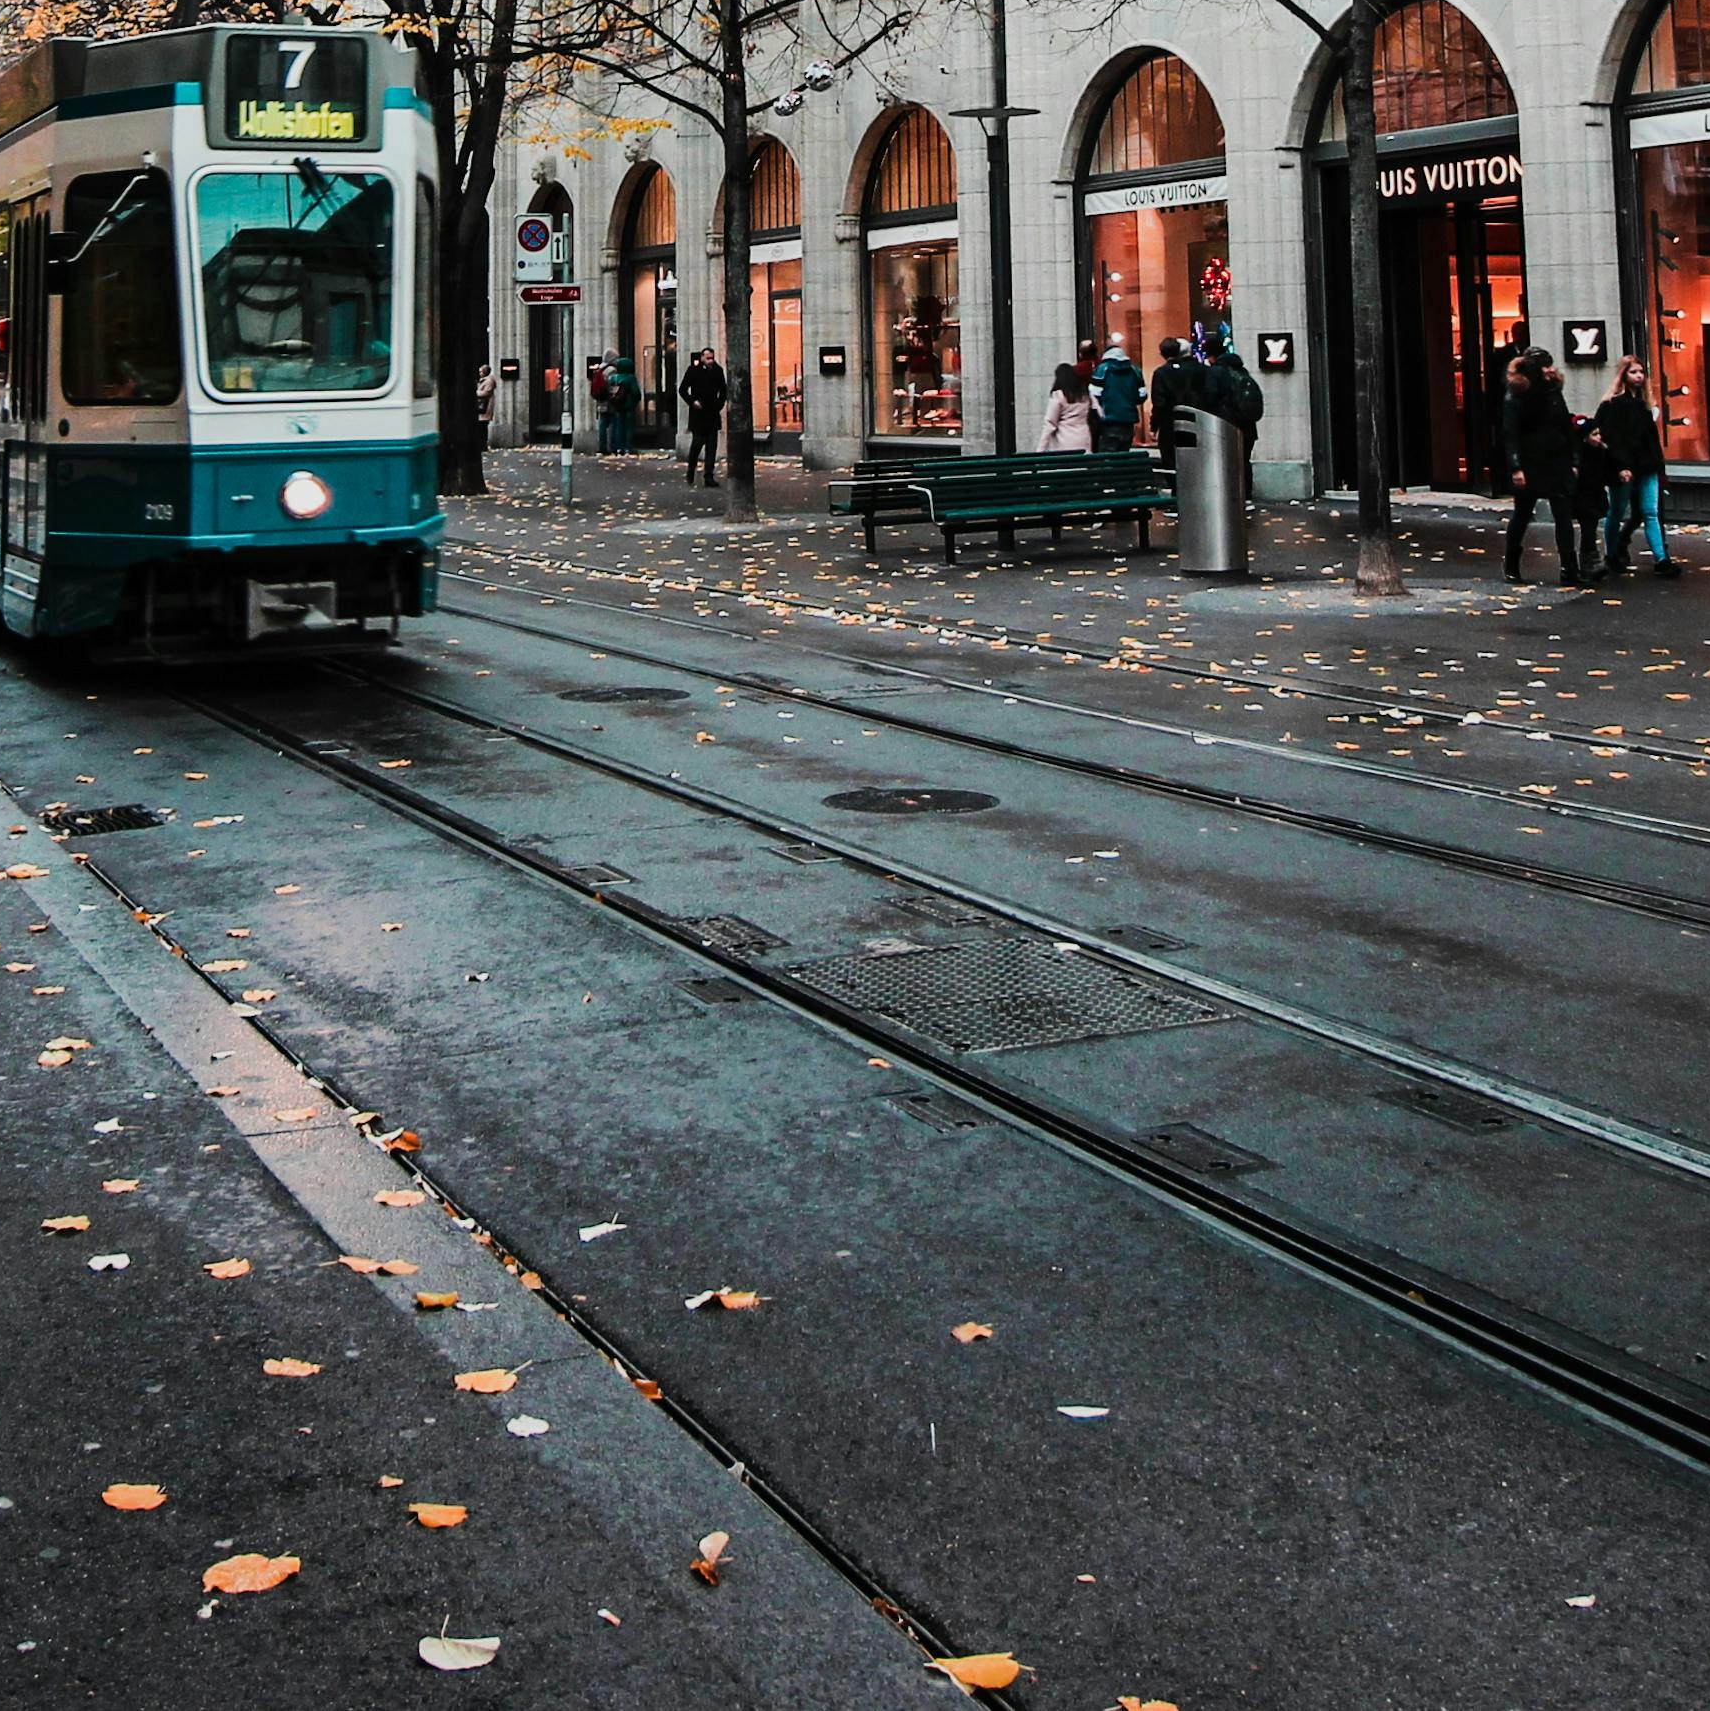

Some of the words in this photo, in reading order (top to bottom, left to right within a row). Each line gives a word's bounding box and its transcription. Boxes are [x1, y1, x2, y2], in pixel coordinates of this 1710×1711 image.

[278, 40, 316, 89] 7
[239, 100, 355, 138] Wollishofen
[1125, 188, 1155, 206] LOUIS
[1159, 182, 1208, 202] VUITTON
[1376, 166, 1417, 198] UIS
[1423, 154, 1524, 192] VUITTON
